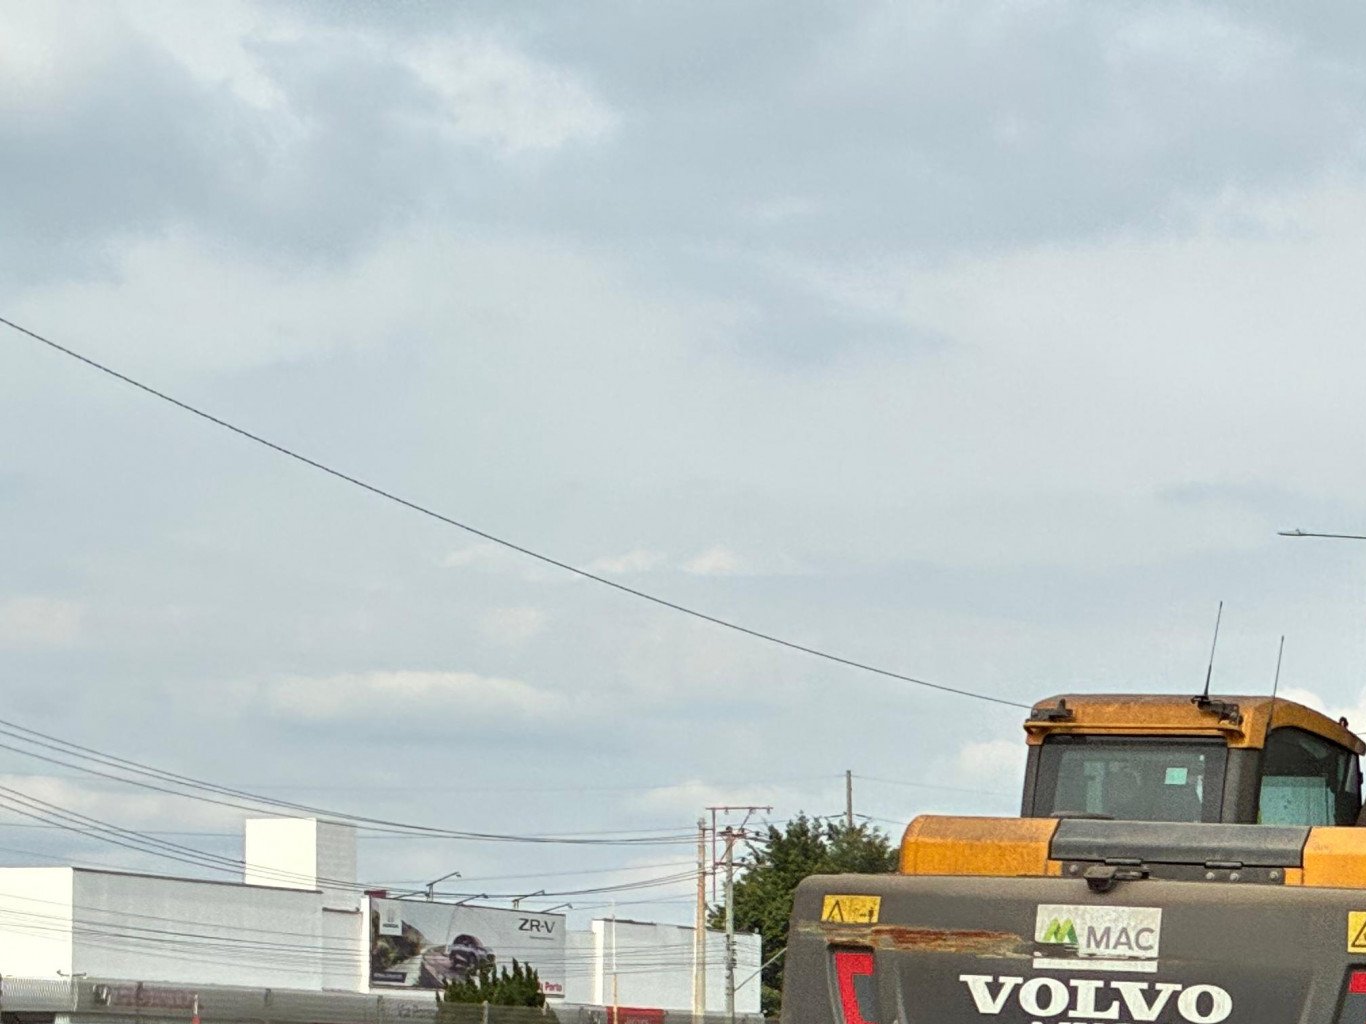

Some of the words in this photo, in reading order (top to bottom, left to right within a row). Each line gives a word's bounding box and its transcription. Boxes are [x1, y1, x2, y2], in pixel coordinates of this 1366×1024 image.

[518, 918, 556, 934] ZR-V
[1086, 925, 1155, 951] MAC
[959, 974, 1233, 1024] VOLVO
